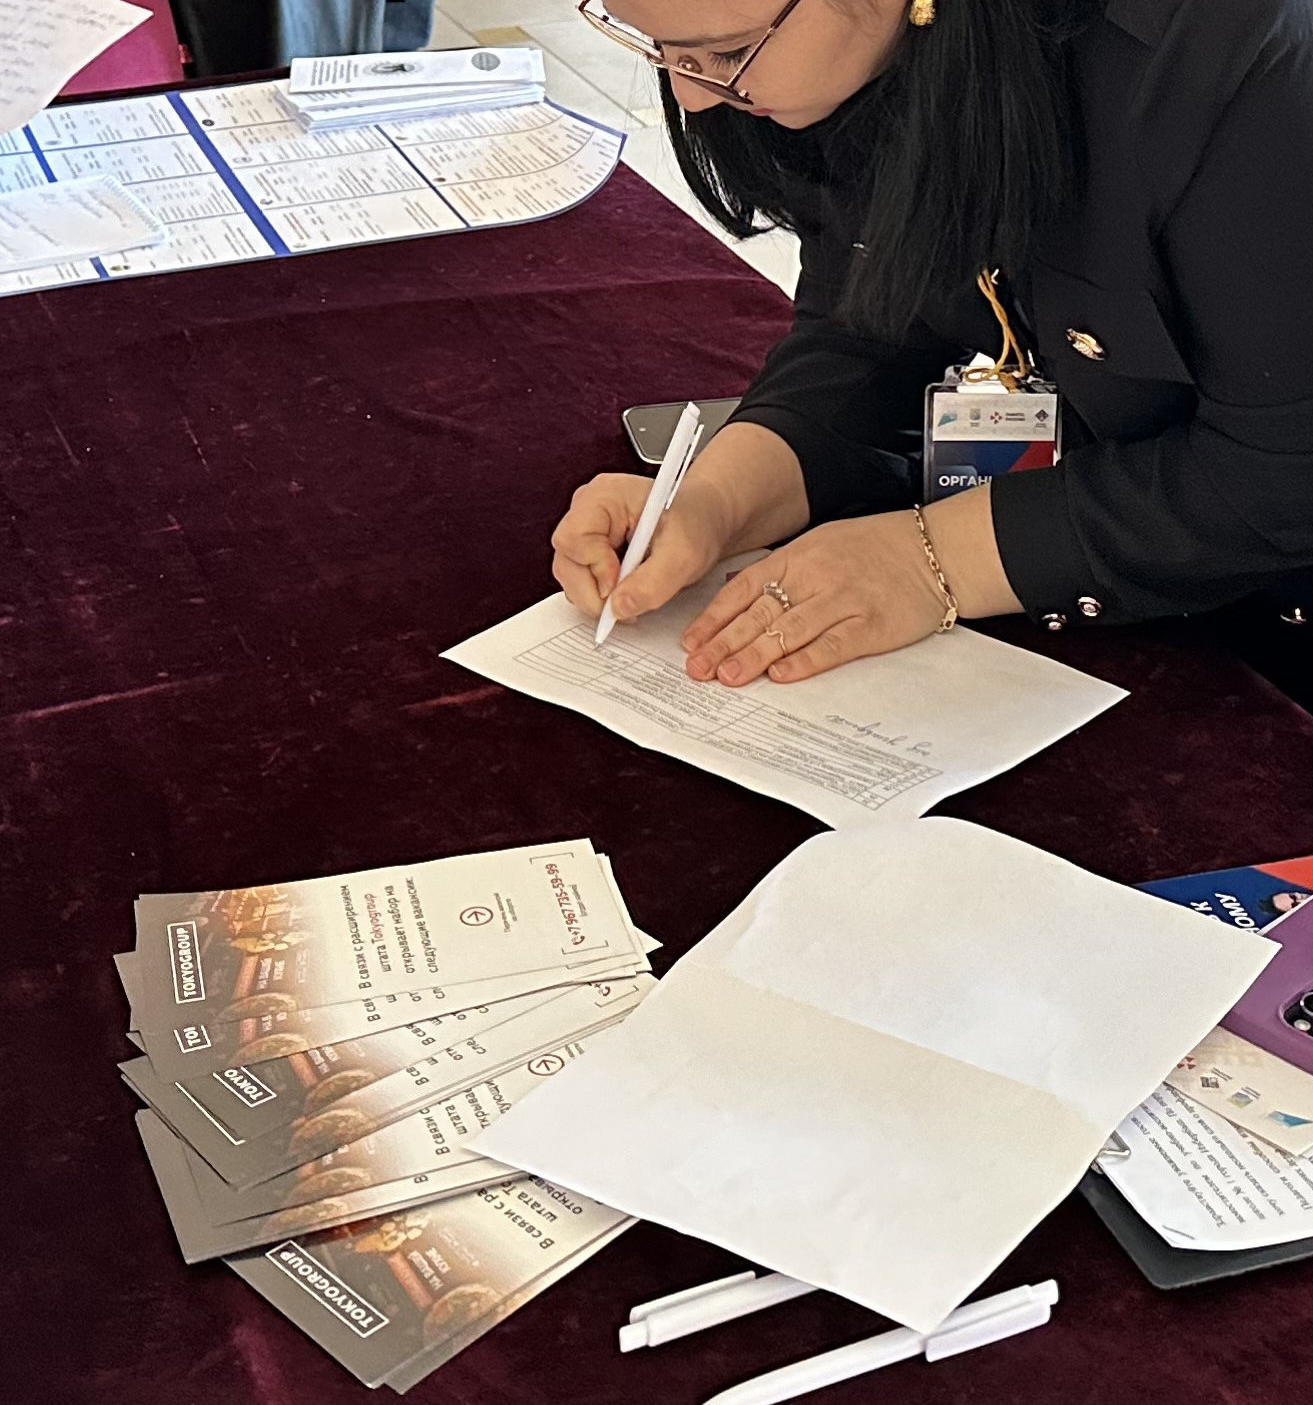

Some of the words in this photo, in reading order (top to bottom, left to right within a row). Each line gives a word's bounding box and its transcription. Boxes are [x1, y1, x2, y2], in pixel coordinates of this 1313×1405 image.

[384, 885, 395, 896] на
[545, 863, 570, 907] 735-59-99
[341, 885, 364, 945] расширением
[364, 893, 384, 944] Tokyogroup
[387, 897, 402, 925] набор
[561, 908, 579, 926] 967
[567, 926, 581, 936] +7
[376, 944, 392, 973] штата
[394, 926, 415, 974] открывает
[416, 921, 438, 973] следующие
[176, 927, 198, 999] TOKYOGROUP
[356, 953, 370, 980] связи
[358, 981, 372, 990] В
[367, 1014, 381, 1023] В
[422, 1037, 436, 1046] В
[415, 1077, 430, 1086] В
[424, 1116, 445, 1145] связи
[445, 1105, 468, 1135] штата
[435, 1146, 450, 1156] В
[493, 1200, 505, 1210] с
[517, 1192, 558, 1223] штата
[504, 1209, 542, 1240] связи
[539, 1237, 555, 1250] В
[279, 1251, 374, 1329] TOKYOGROUP
